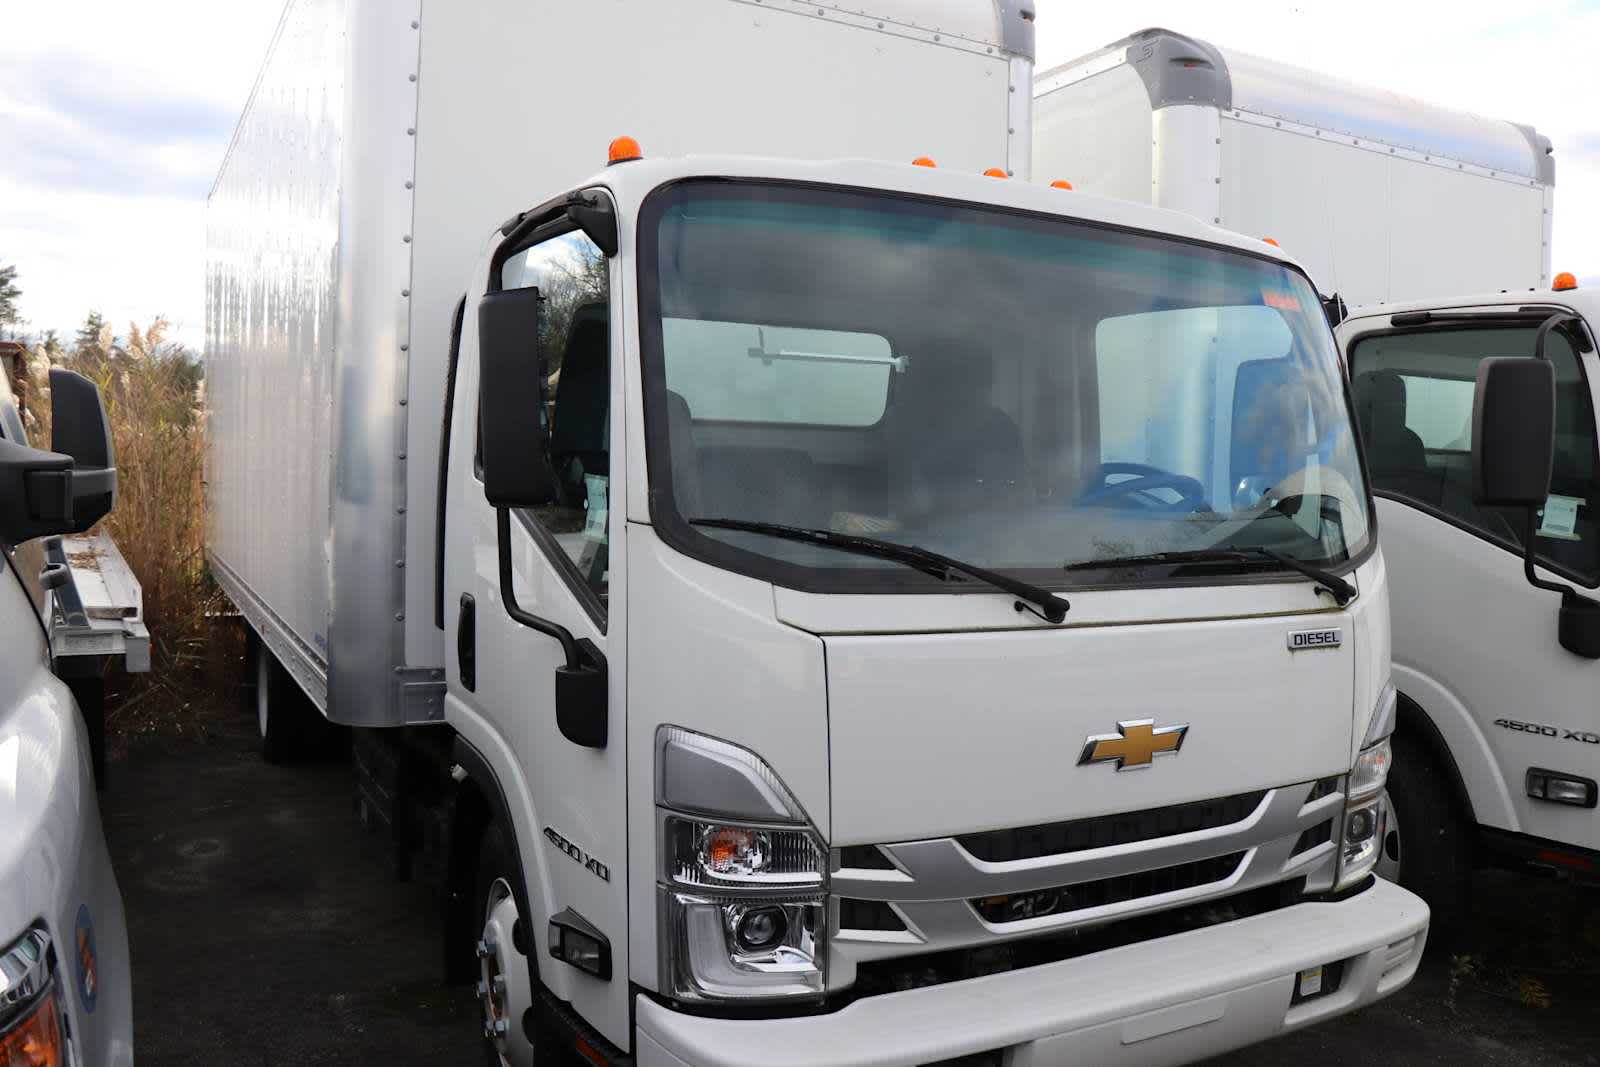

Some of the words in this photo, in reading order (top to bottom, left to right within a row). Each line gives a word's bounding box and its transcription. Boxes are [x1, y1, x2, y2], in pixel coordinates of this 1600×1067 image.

[1294, 631, 1340, 646] DIESEL
[1494, 719, 1558, 737] 4500
[1562, 729, 1600, 744] XD
